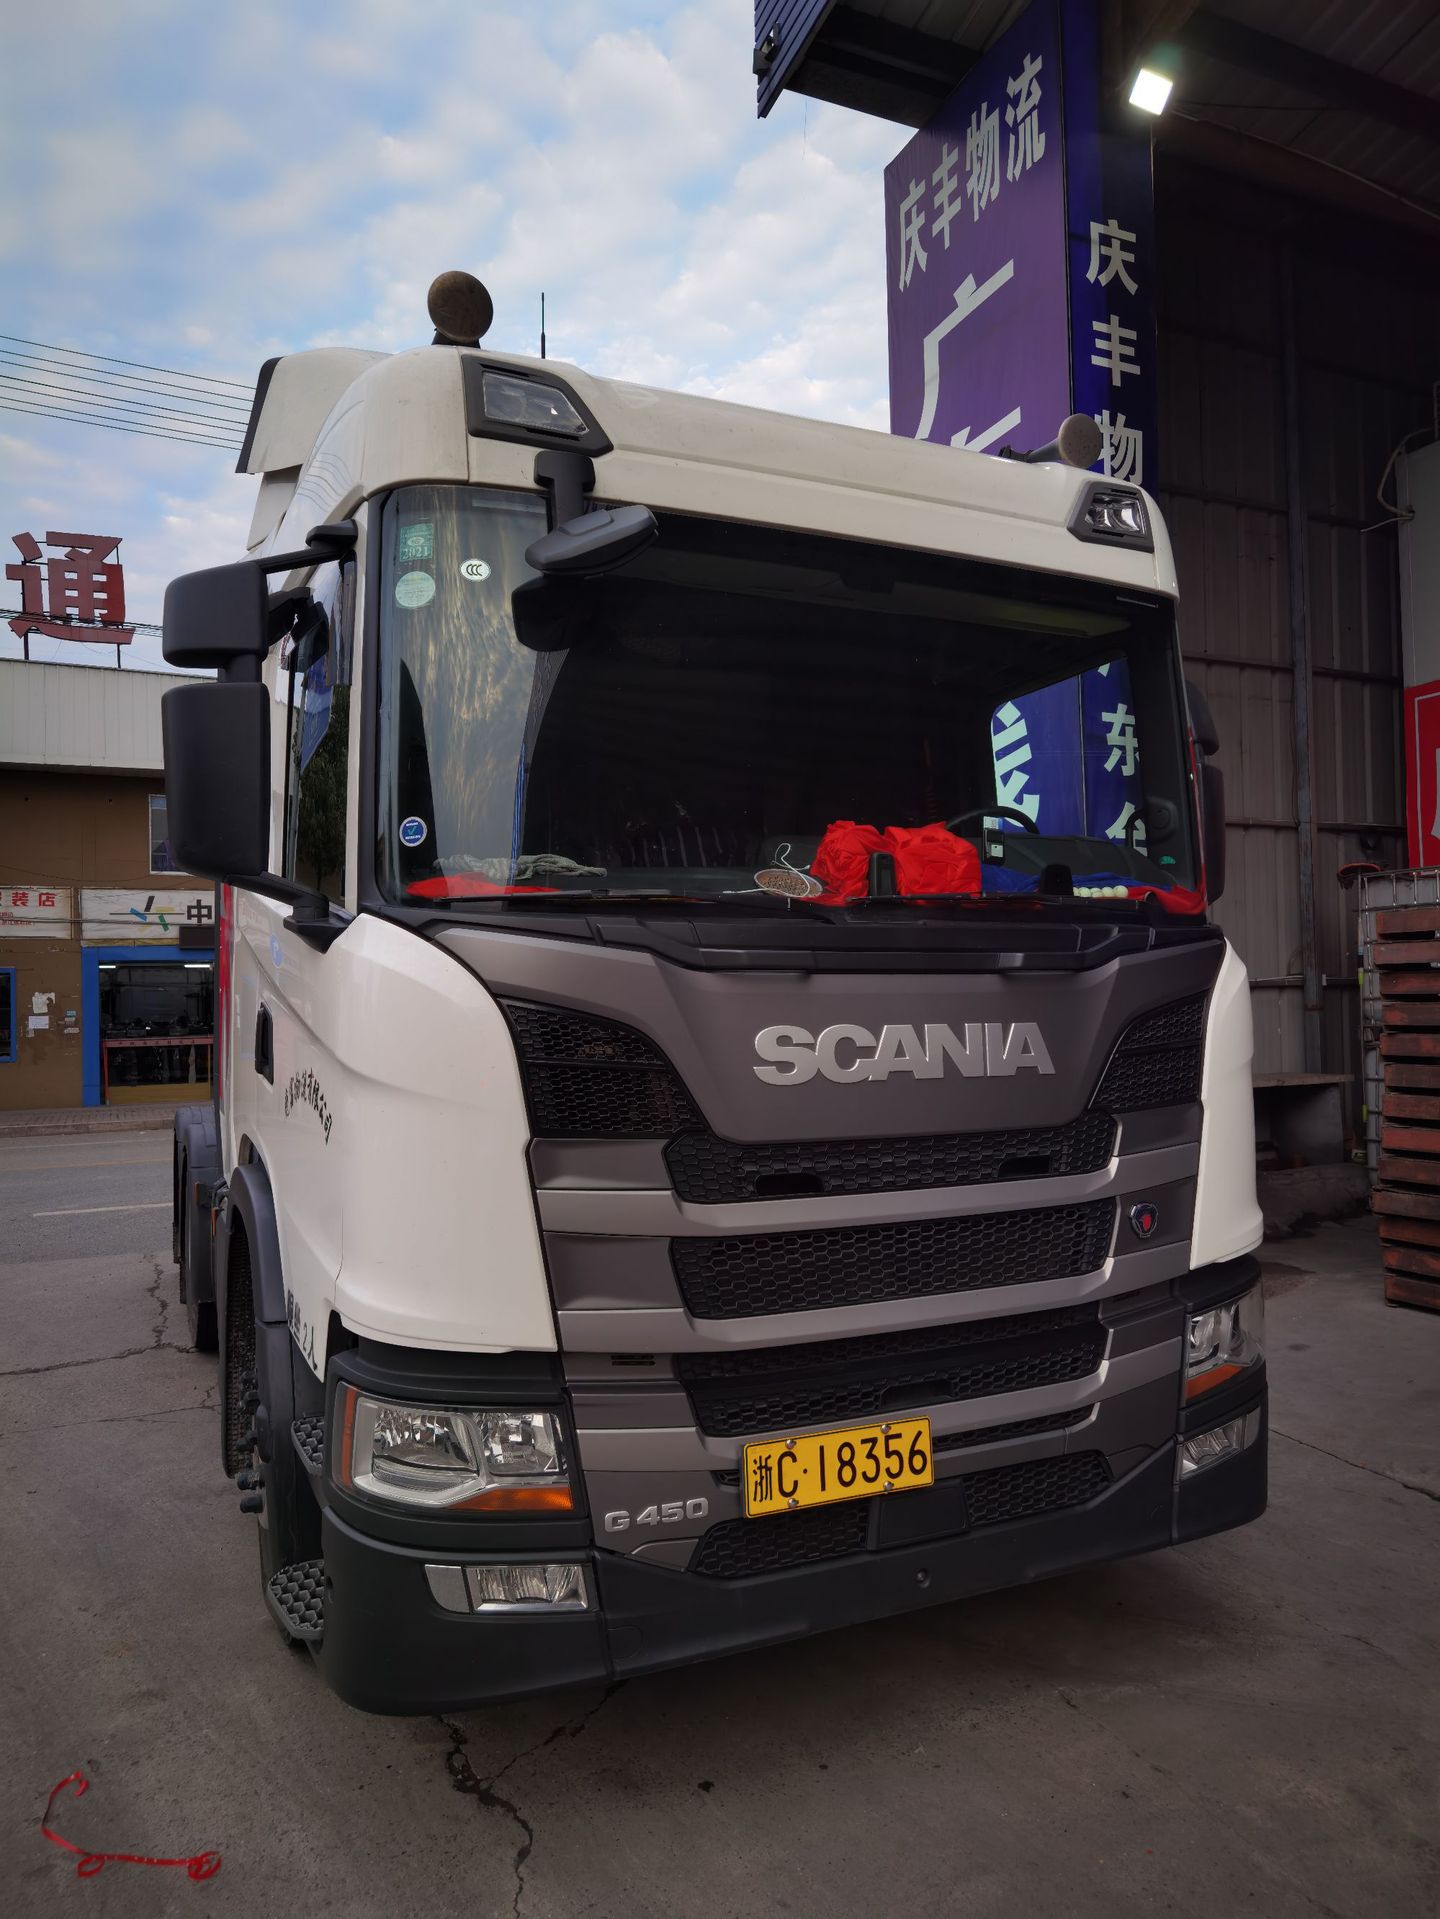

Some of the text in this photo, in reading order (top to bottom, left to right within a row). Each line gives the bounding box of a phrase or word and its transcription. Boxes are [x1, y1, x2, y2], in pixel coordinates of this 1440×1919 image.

[899, 52, 1045, 292] 庆丰物流
[402, 546, 428, 560] 2021
[5, 530, 136, 645] 通
[0, 891, 57, 907] 装店
[753, 1021, 1056, 1086] SCANIA
[604, 1497, 709, 1533] G 450
